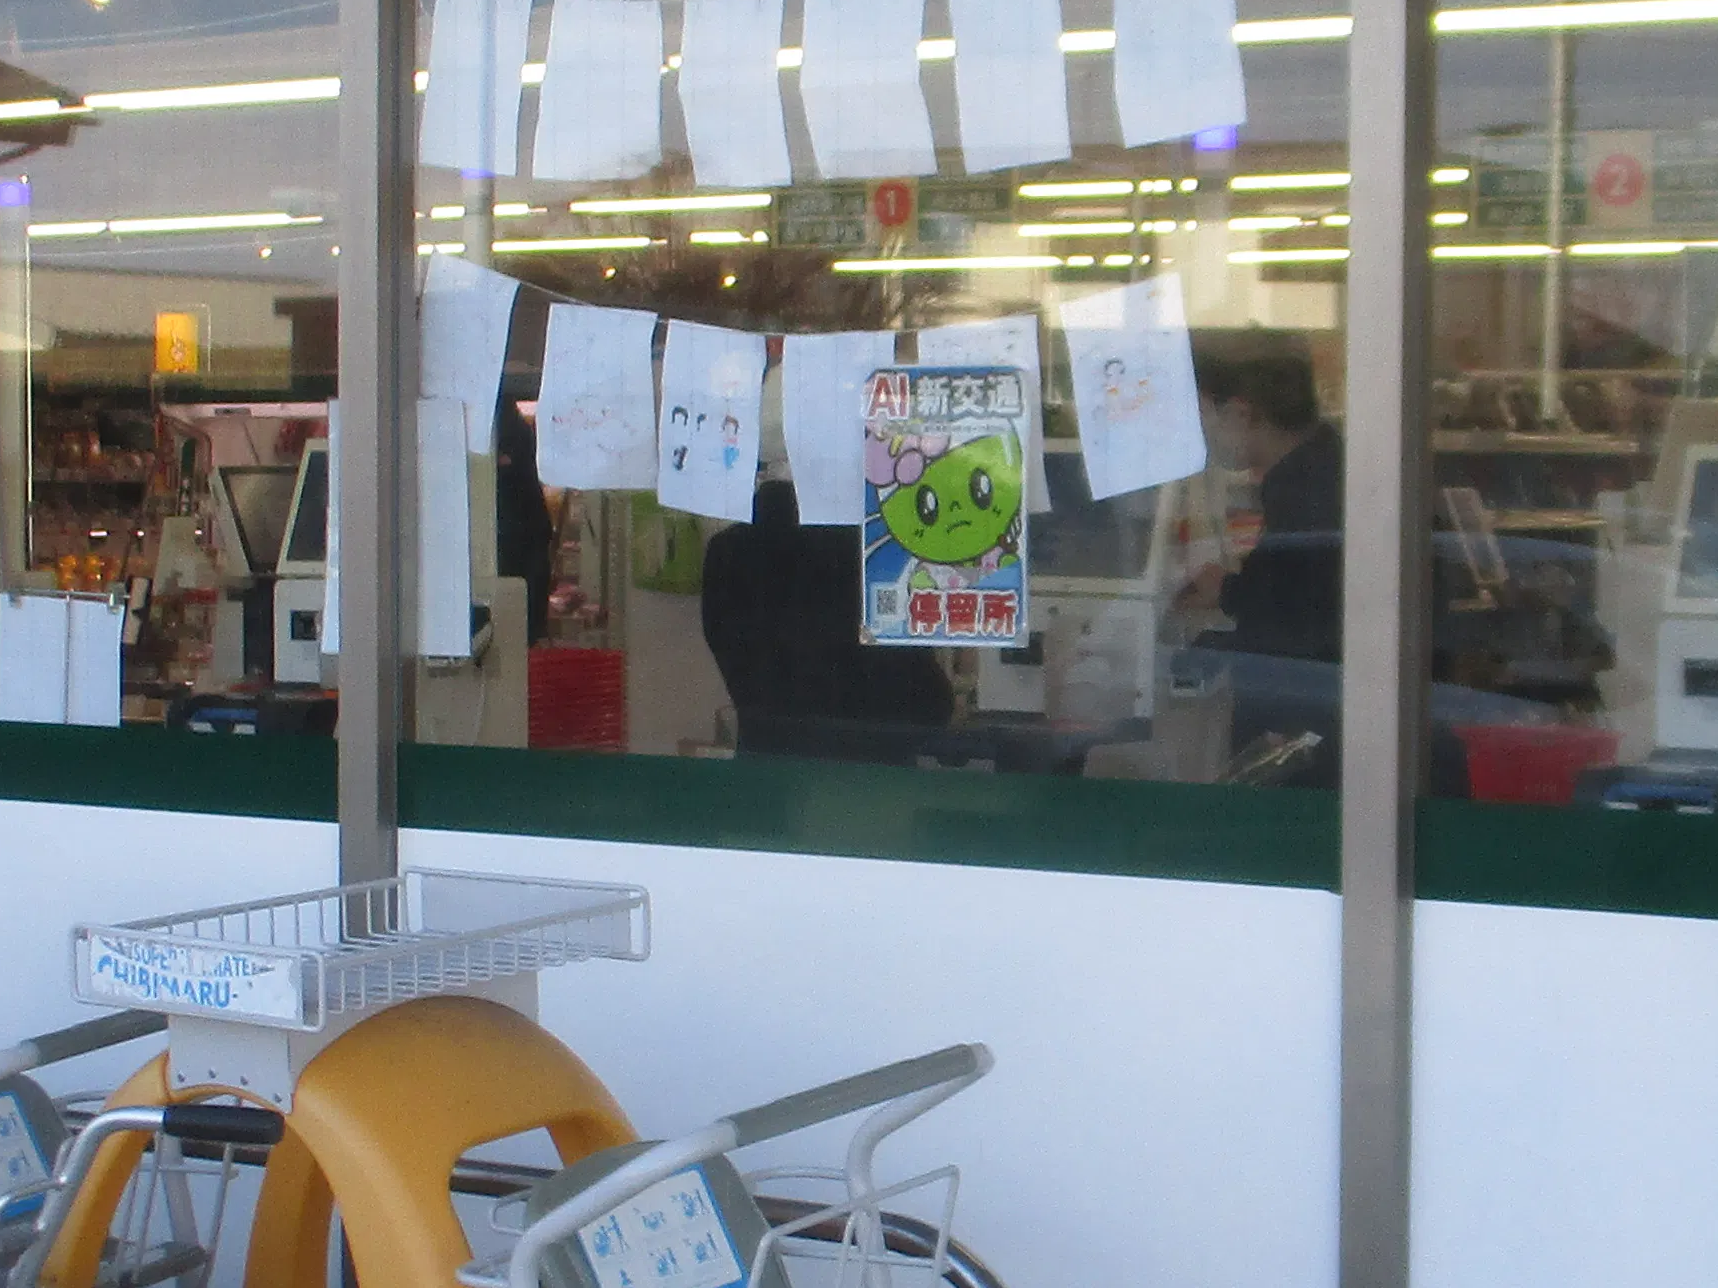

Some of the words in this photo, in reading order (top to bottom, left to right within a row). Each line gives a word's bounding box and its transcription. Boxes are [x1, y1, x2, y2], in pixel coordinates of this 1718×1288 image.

[866, 372, 910, 420] AI
[917, 375, 1023, 418] 新交通
[907, 589, 1020, 637] 停留所
